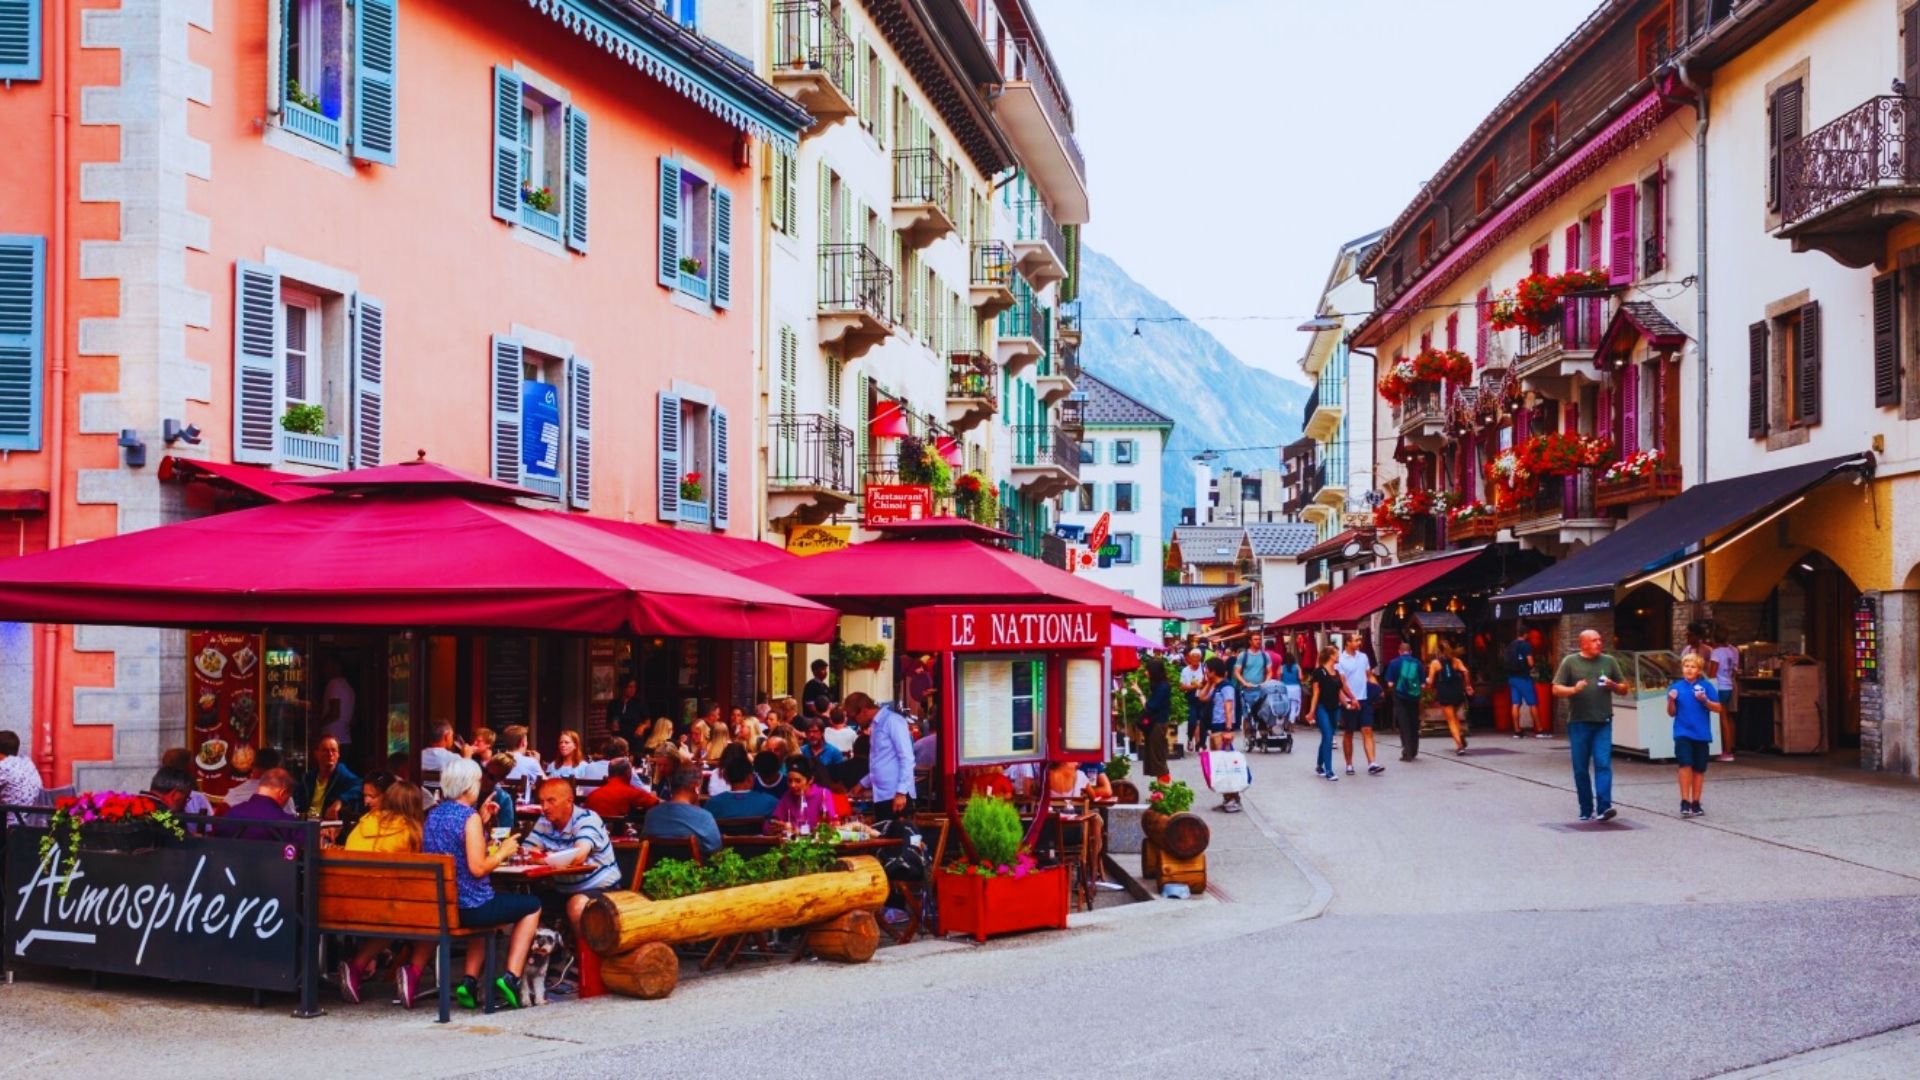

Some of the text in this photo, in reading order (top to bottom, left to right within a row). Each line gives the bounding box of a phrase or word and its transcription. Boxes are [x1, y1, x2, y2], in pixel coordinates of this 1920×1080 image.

[873, 491, 922, 500] Restaurant
[873, 500, 907, 509] Chinois
[872, 515, 890, 524] Chez
[1533, 597, 1563, 615] RICHARD
[951, 612, 1098, 646] LE NATIONAL
[267, 670, 280, 681] de
[15, 842, 283, 966] Atmosphère
